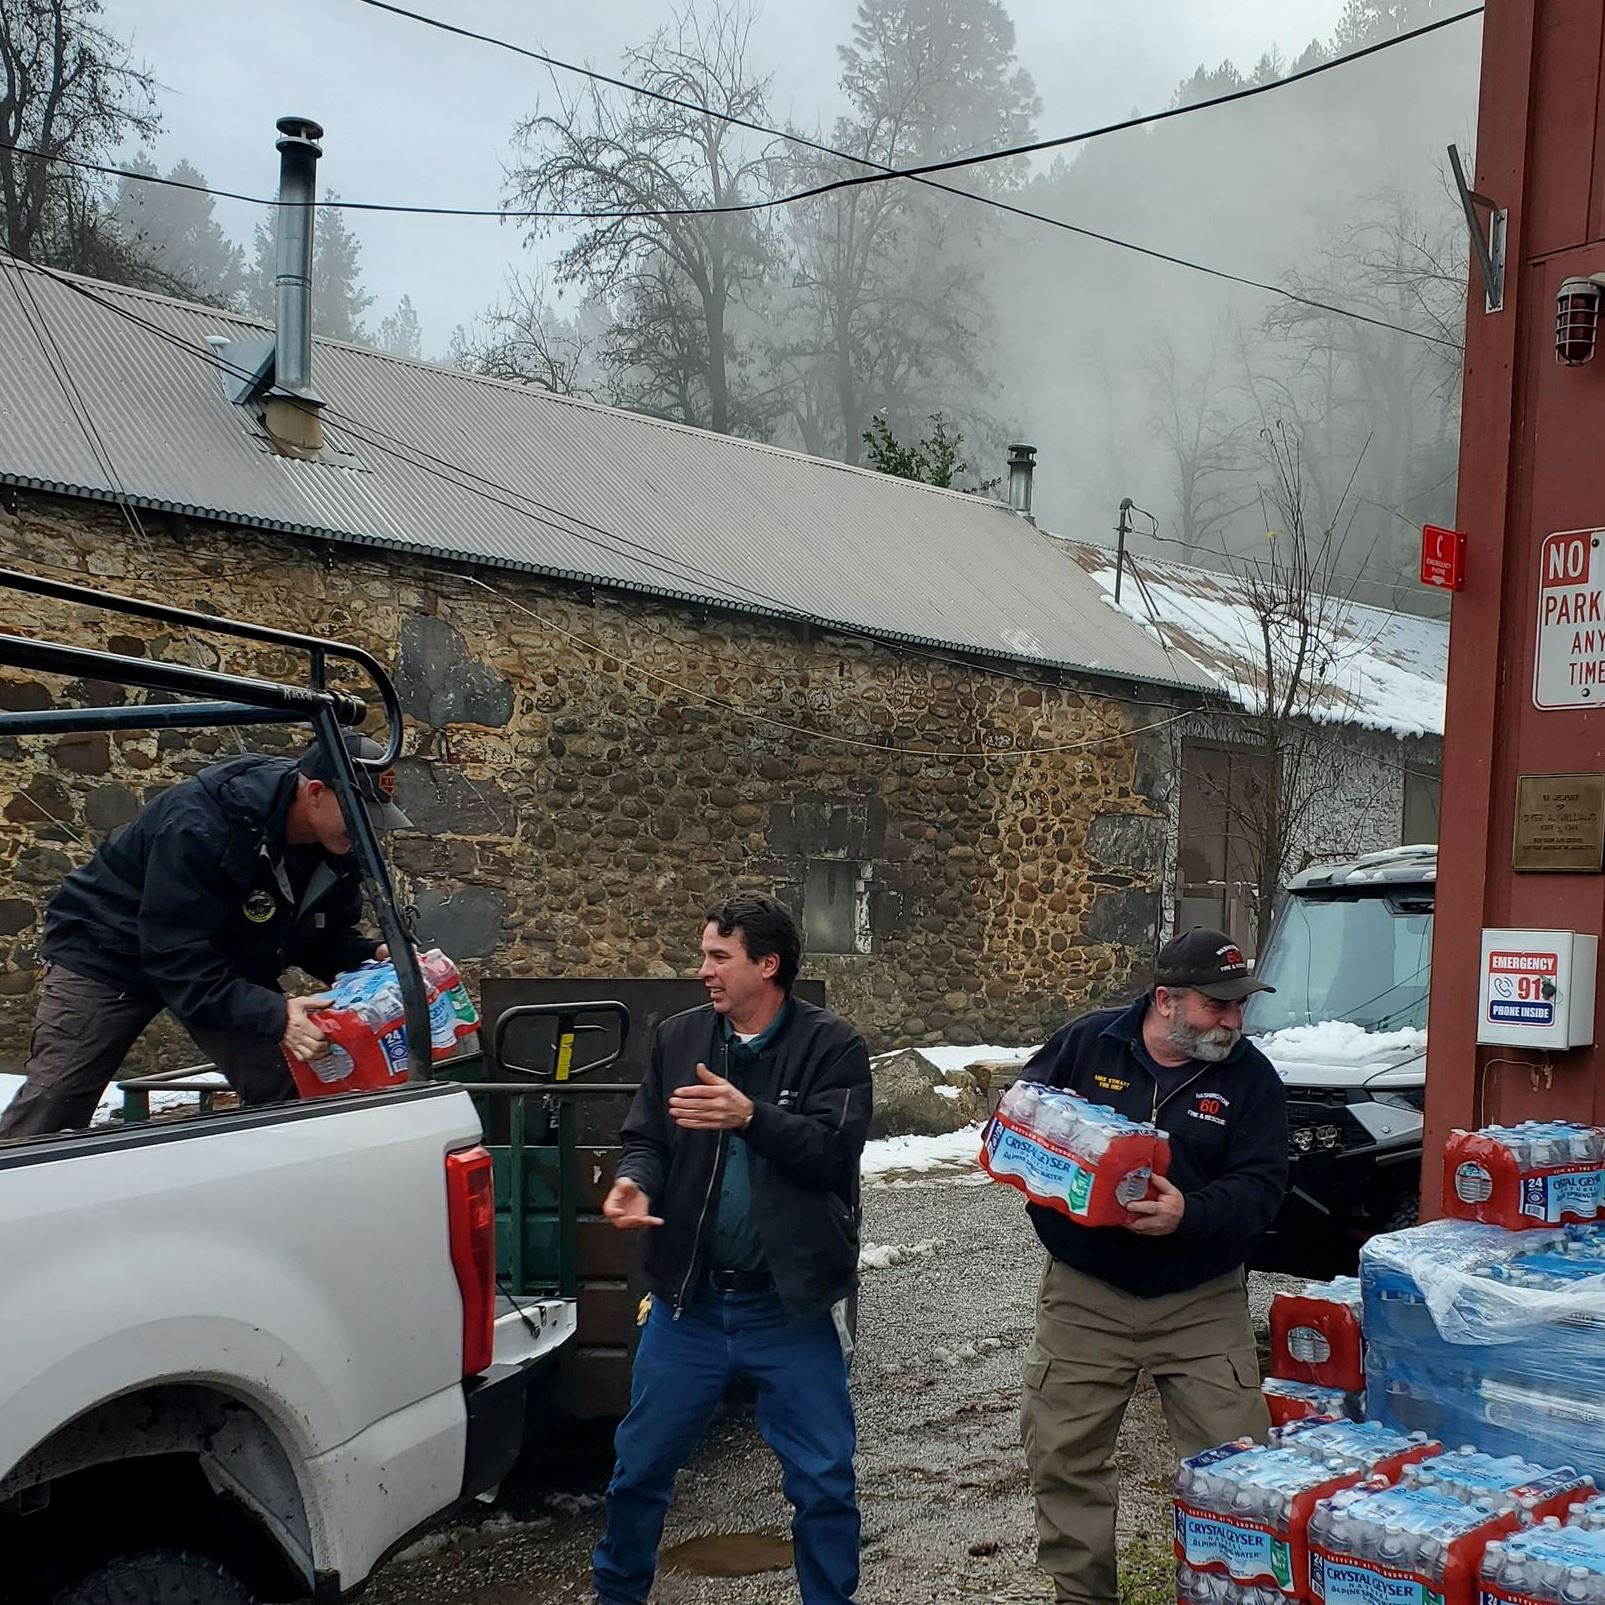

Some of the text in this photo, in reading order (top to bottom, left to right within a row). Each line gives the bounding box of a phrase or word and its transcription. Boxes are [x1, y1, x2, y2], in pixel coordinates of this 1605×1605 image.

[1549, 540, 1584, 580] NO
[1545, 591, 1605, 626] PARK
[1569, 661, 1605, 686] TIME
[1492, 955, 1555, 971] EMERGENCY
[1492, 1005, 1550, 1019] PHONE INSIDE
[385, 1029, 401, 1044] 24
[1195, 1092, 1230, 1107] WASHINGTON
[1200, 1099, 1219, 1114] 60
[1187, 1109, 1199, 1118] FIRE
[1528, 1177, 1543, 1188] 24
[1188, 1521, 1264, 1547] CRYSTAL GEYSER
[1193, 1538, 1218, 1549] ALPINE
[1234, 1549, 1259, 1559] WATER
[1326, 1567, 1415, 1597] CRYSTAL GEYSER
[1331, 1585, 1359, 1596] ALPINE
